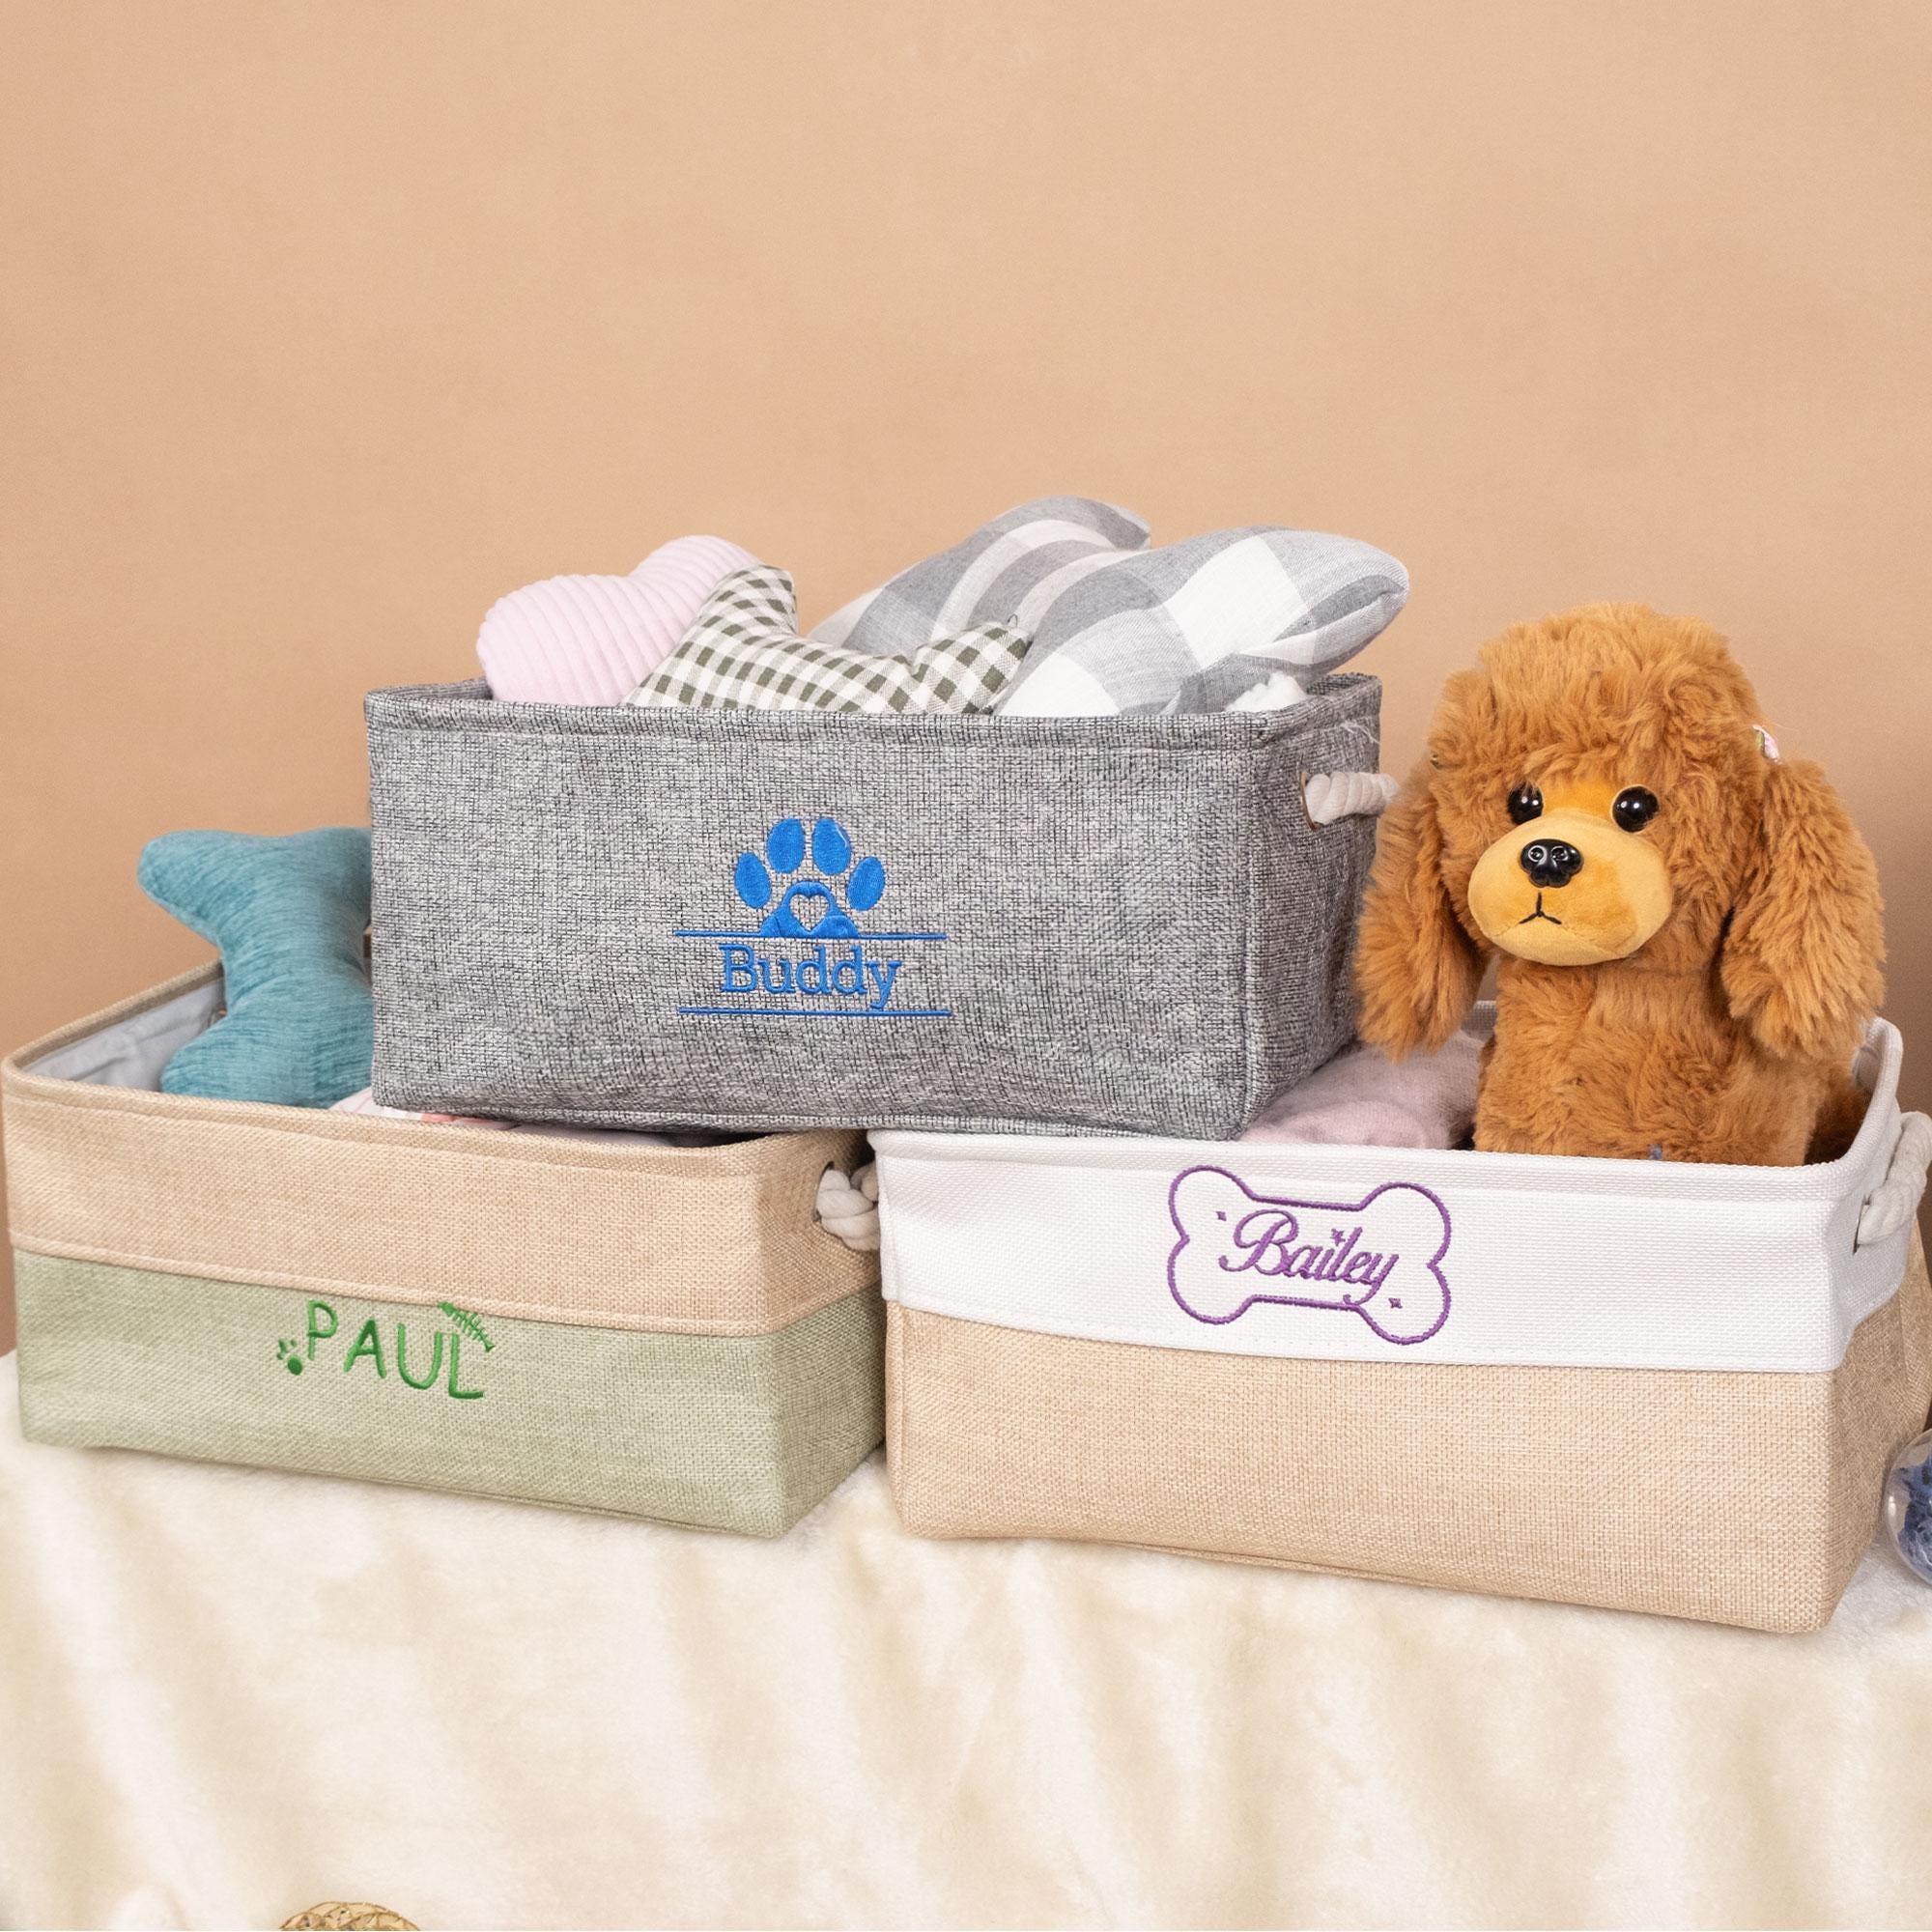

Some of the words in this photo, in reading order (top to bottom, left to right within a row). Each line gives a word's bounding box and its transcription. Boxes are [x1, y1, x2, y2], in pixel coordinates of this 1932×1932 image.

[719, 943, 902, 1009] Buddy
[1218, 1208, 1399, 1305] Bailey
[306, 1299, 484, 1400] PAUL
